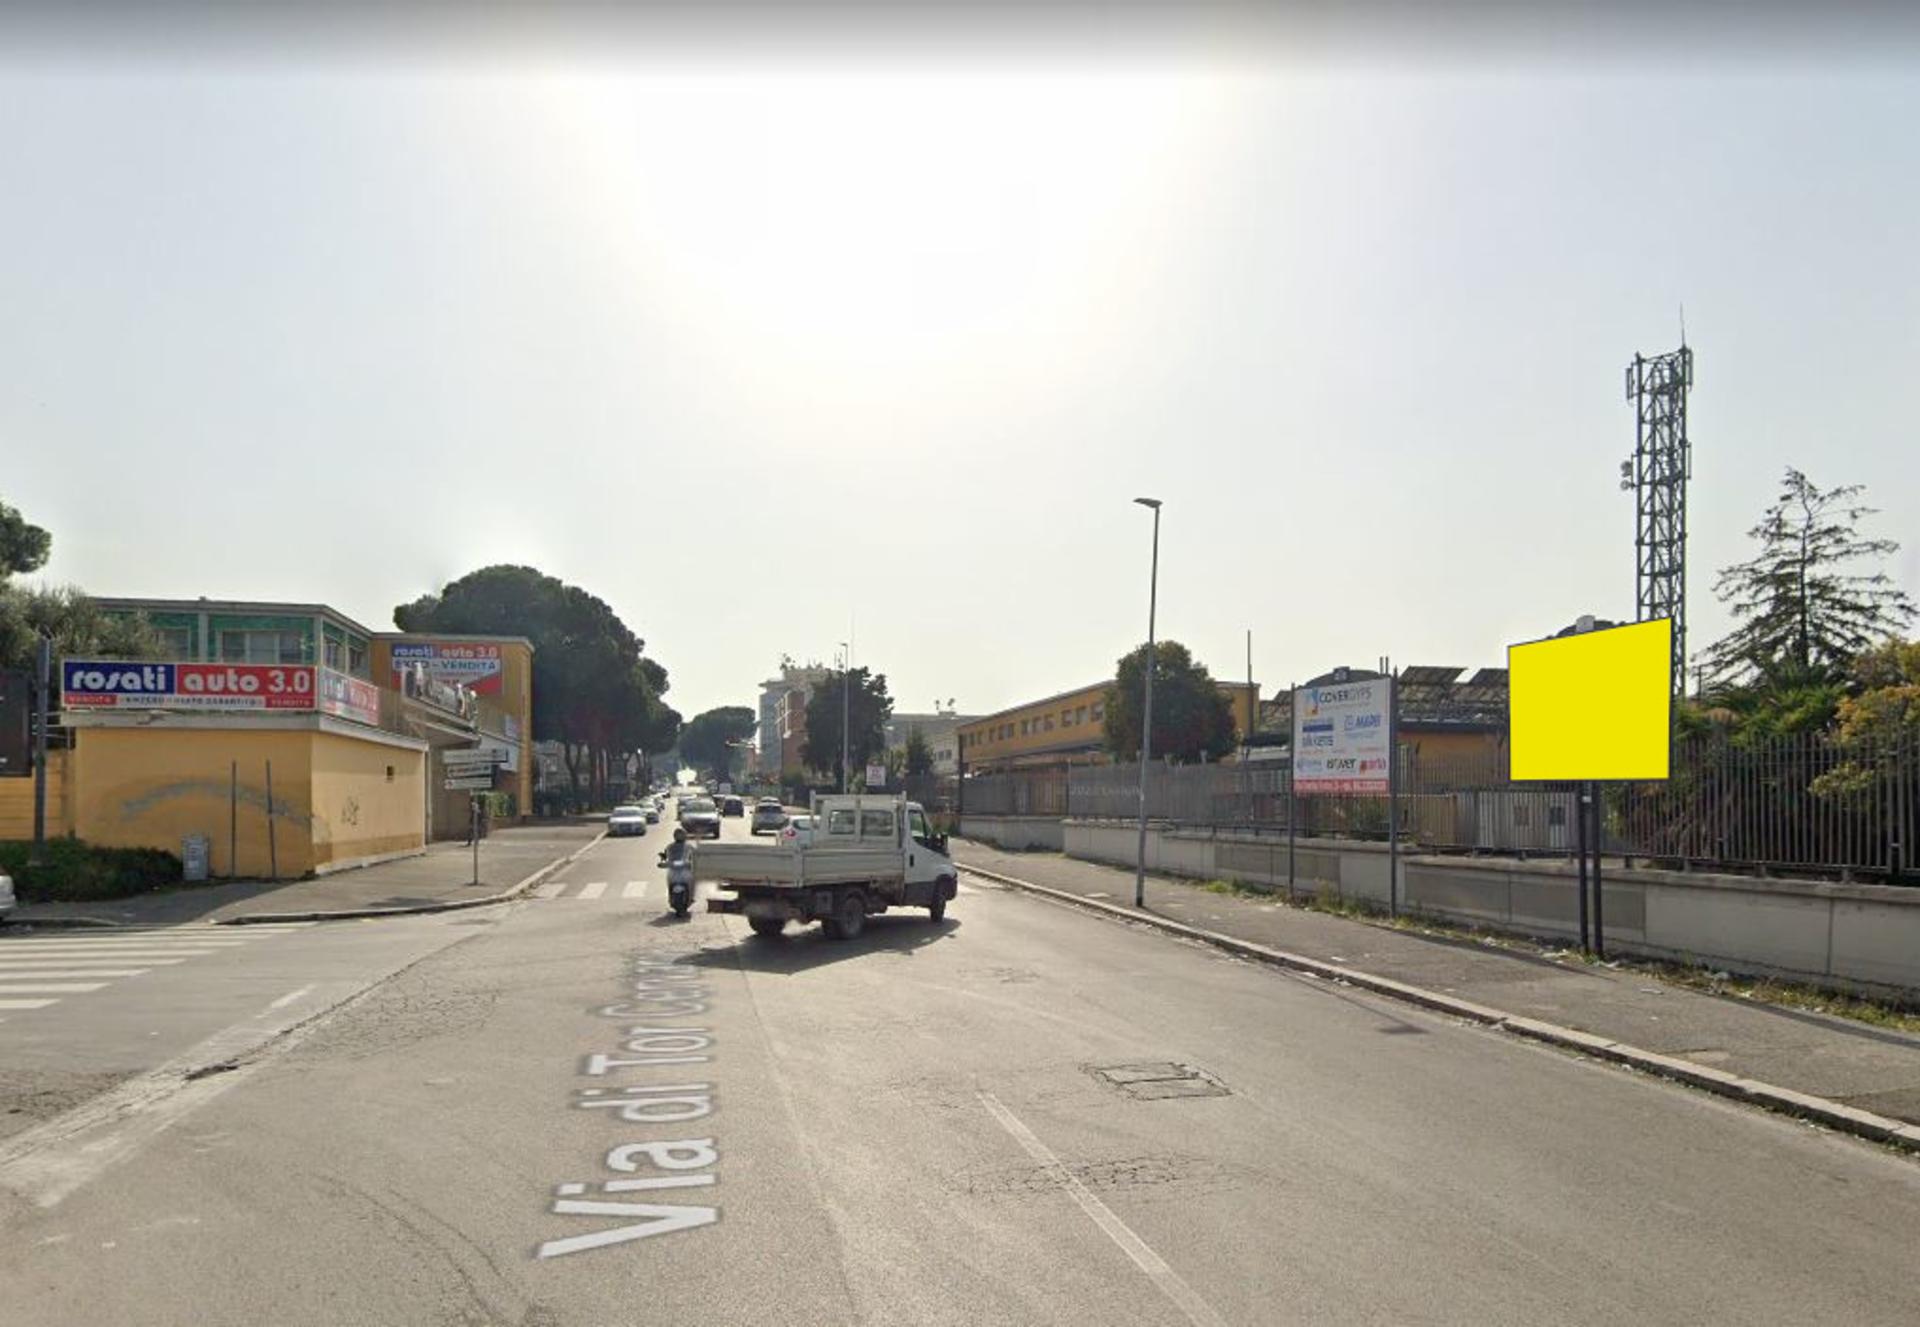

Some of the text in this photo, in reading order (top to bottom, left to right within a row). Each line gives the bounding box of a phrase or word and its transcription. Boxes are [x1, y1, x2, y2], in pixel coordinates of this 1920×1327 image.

[394, 645, 498, 658] rosati auto 3.0
[441, 660, 496, 671] VENDITA
[72, 666, 311, 693] rosati auto 3.0
